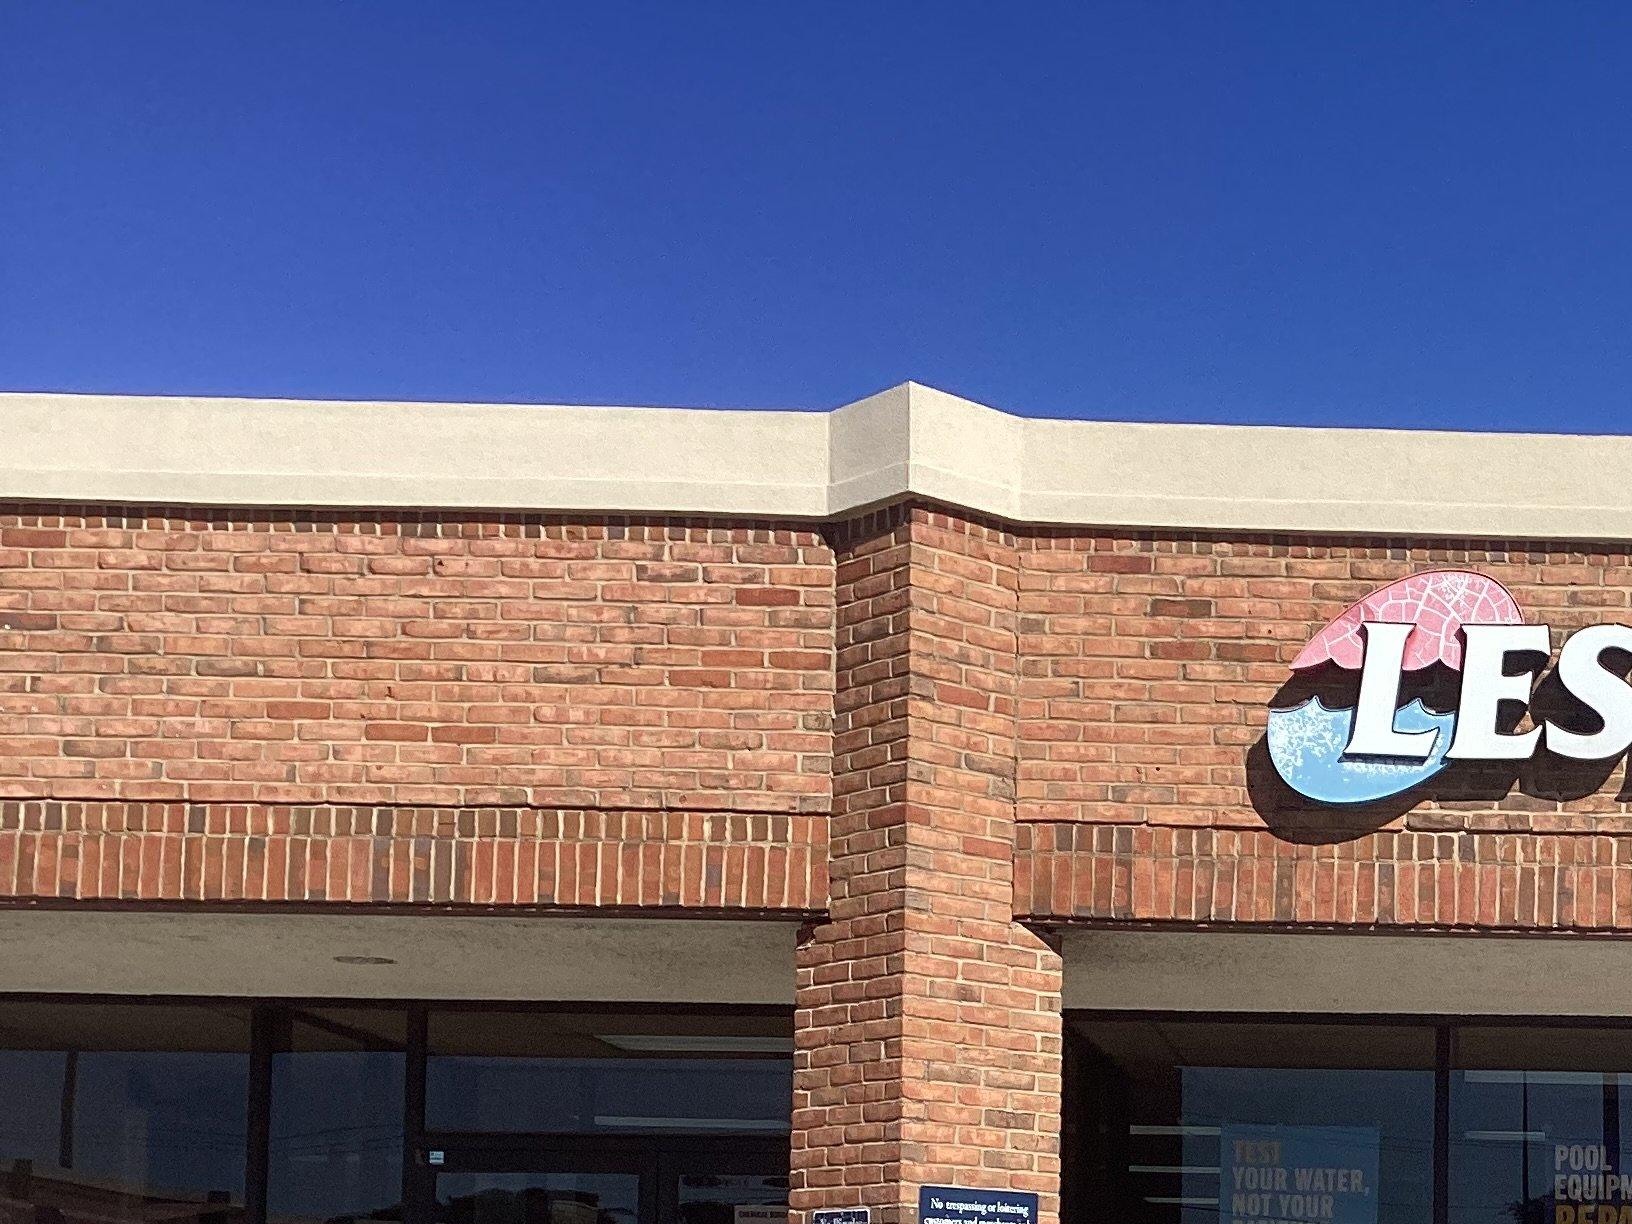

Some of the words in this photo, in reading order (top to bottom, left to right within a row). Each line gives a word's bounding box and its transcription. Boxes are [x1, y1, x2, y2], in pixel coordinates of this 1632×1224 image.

[1231, 1139, 1281, 1165] TEST
[1555, 1144, 1612, 1171] POOL
[1232, 1166, 1287, 1191] YOUR
[1294, 1167, 1370, 1197] WATER,
[930, 1197, 943, 1209] No
[945, 1201, 987, 1216] trespassing
[987, 1204, 996, 1212] or
[997, 1201, 1029, 1218] loitering
[1232, 1193, 1272, 1217] NOT
[1279, 1193, 1333, 1218] YOUR
